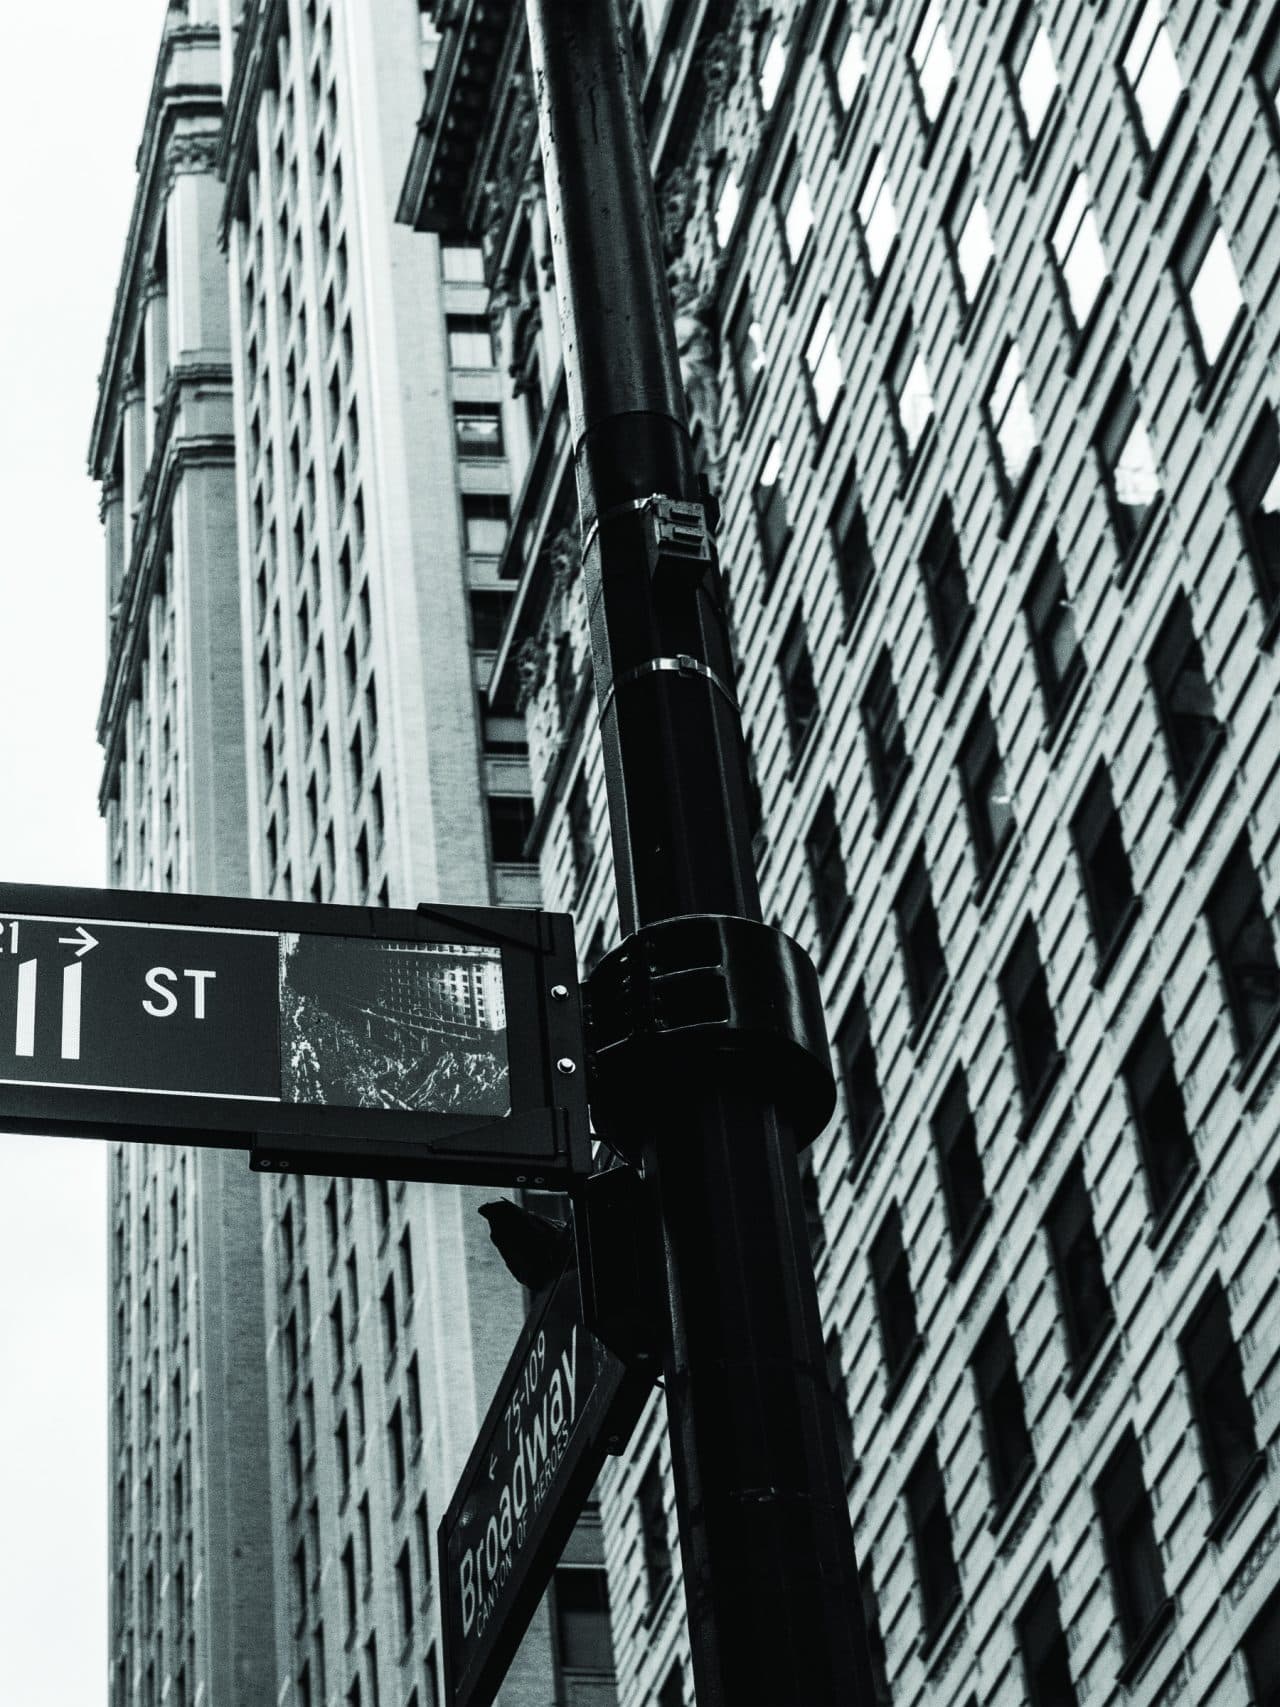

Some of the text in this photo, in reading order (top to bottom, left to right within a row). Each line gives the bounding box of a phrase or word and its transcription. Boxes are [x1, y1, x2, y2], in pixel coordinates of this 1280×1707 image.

[142, 966, 217, 1019] ST
[504, 1329, 545, 1451] 75-109
[460, 1324, 577, 1638] Broadway
[476, 1419, 569, 1638] CANYON OF HEROES
